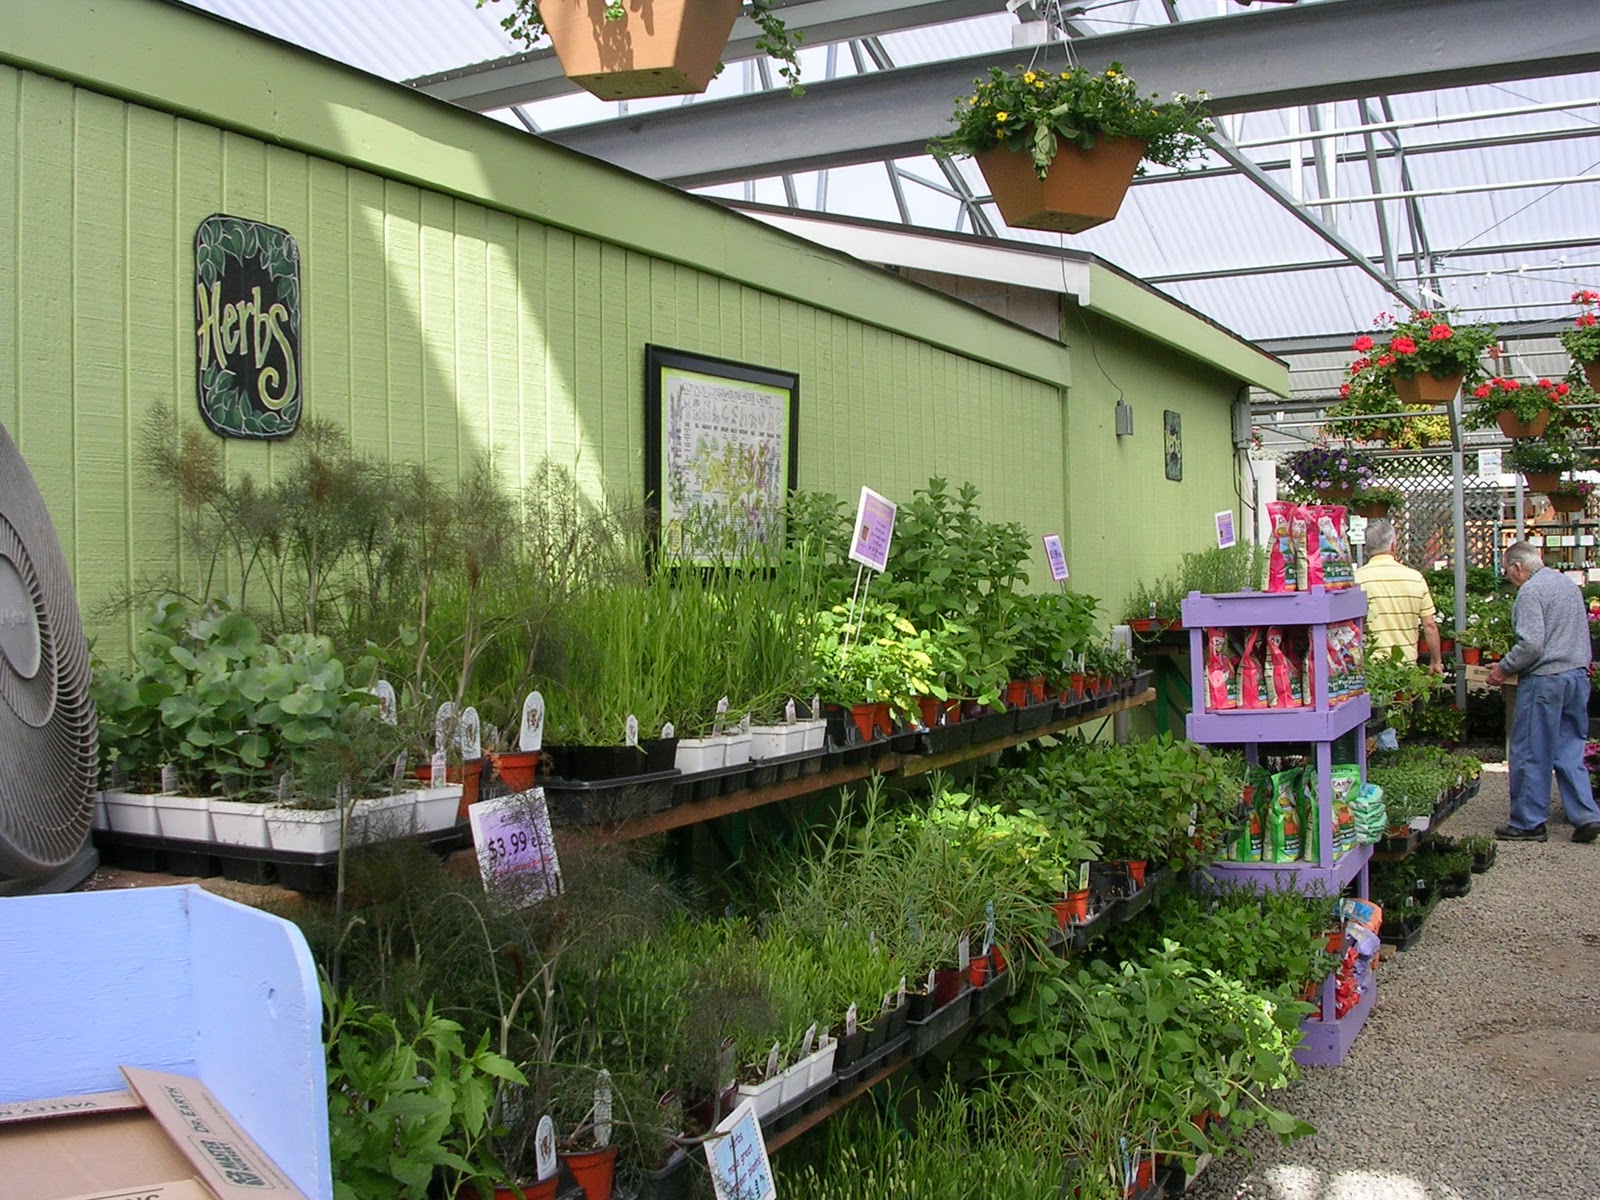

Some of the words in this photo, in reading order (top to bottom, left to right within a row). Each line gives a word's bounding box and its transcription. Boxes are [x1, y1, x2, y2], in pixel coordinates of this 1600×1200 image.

[197, 281, 297, 410] Herbs
[487, 830, 528, 861] $3.99
[164, 1086, 197, 1117] EARTH
[191, 1118, 210, 1133] DR.
[200, 1139, 240, 1170] MASTER
